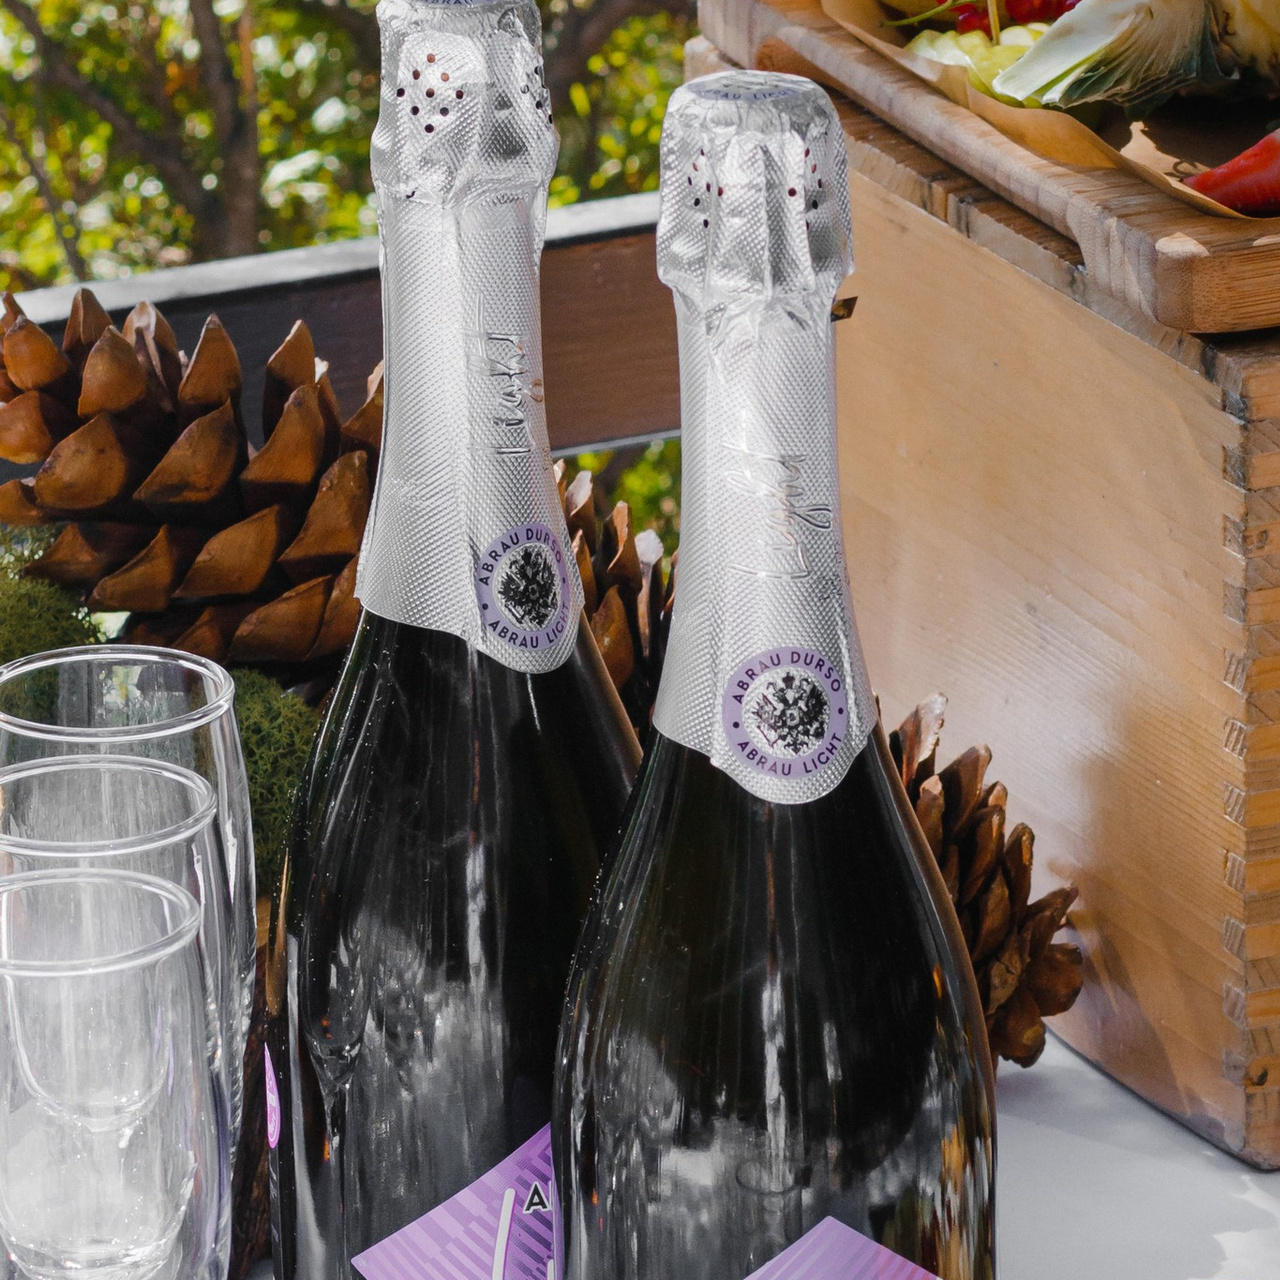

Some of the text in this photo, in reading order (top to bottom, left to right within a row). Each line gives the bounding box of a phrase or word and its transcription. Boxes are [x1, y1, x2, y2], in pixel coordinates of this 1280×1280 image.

[479, 527, 562, 587] ABRAU DURSO
[488, 601, 570, 650] ABRAU LIGHT
[732, 651, 841, 705] ABRAU DURSO
[737, 732, 843, 776] ABRAU LIGHT
